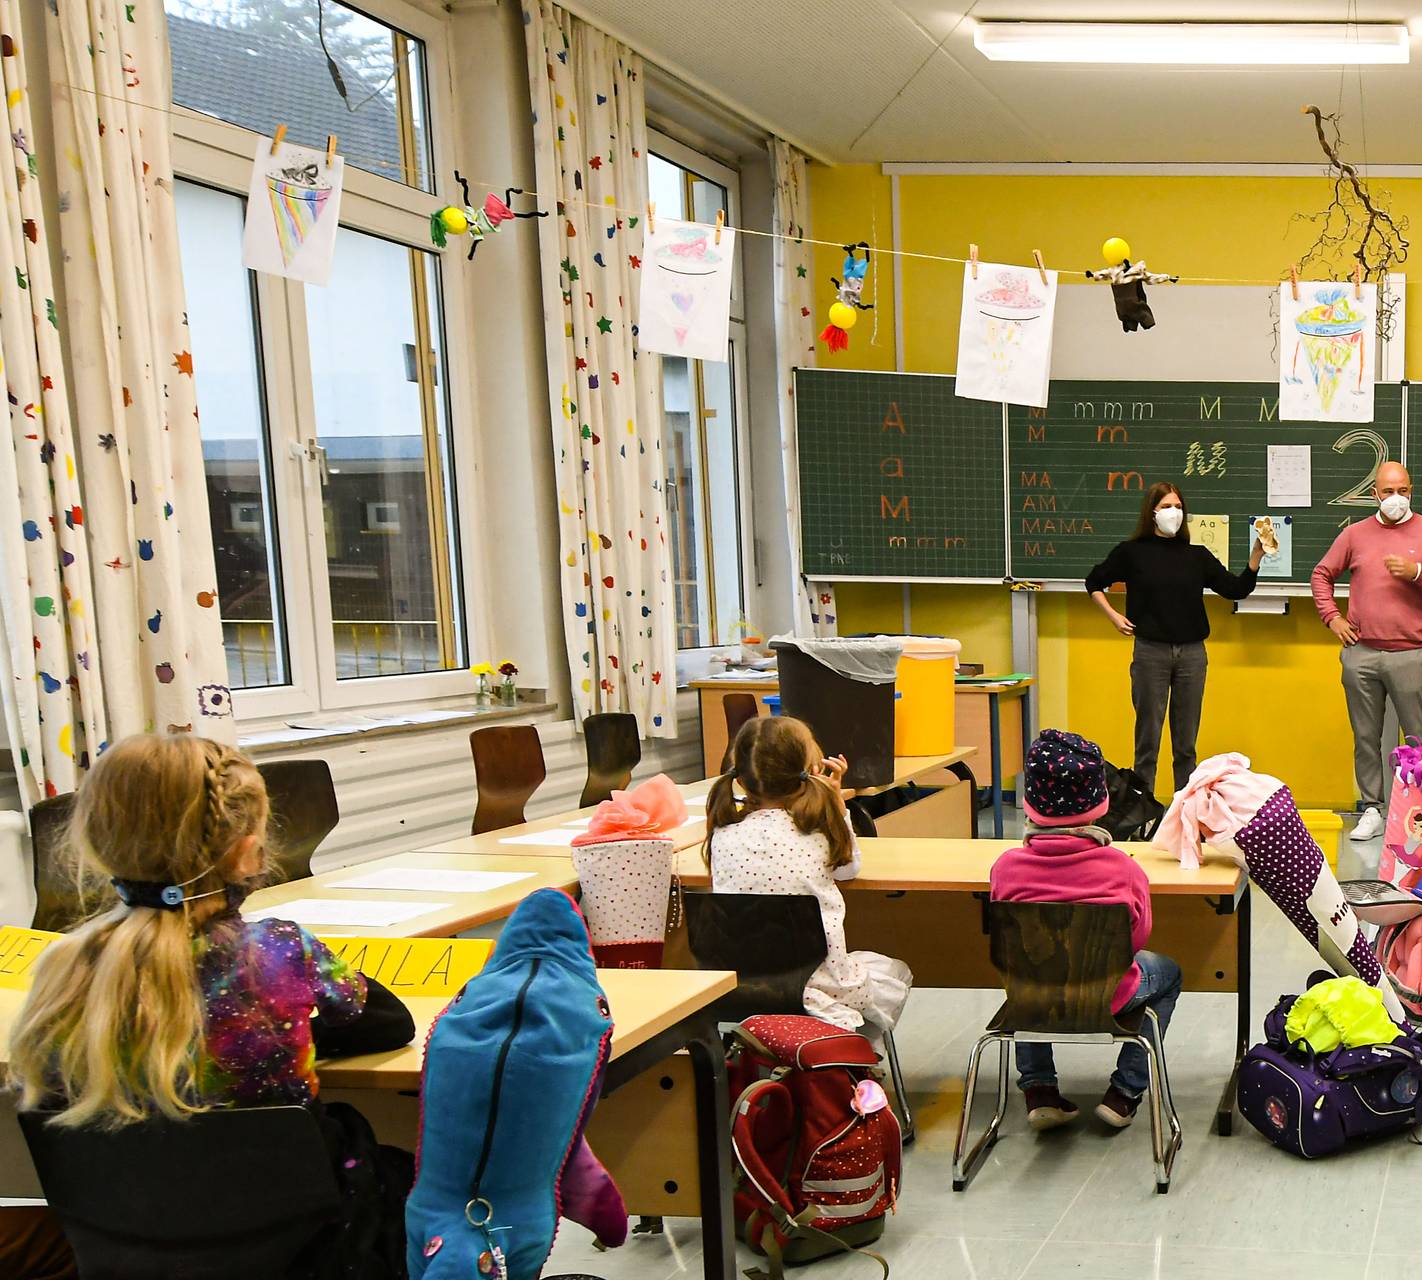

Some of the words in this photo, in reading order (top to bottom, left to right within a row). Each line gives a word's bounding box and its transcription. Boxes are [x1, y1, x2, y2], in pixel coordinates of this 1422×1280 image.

[881, 401, 907, 434] A
[1200, 396, 1221, 420] M
[1028, 425, 1045, 442] M
[879, 455, 904, 477] a
[881, 494, 911, 522] M
[1023, 495, 1057, 512] AM
[1022, 518, 1095, 534] MAMA
